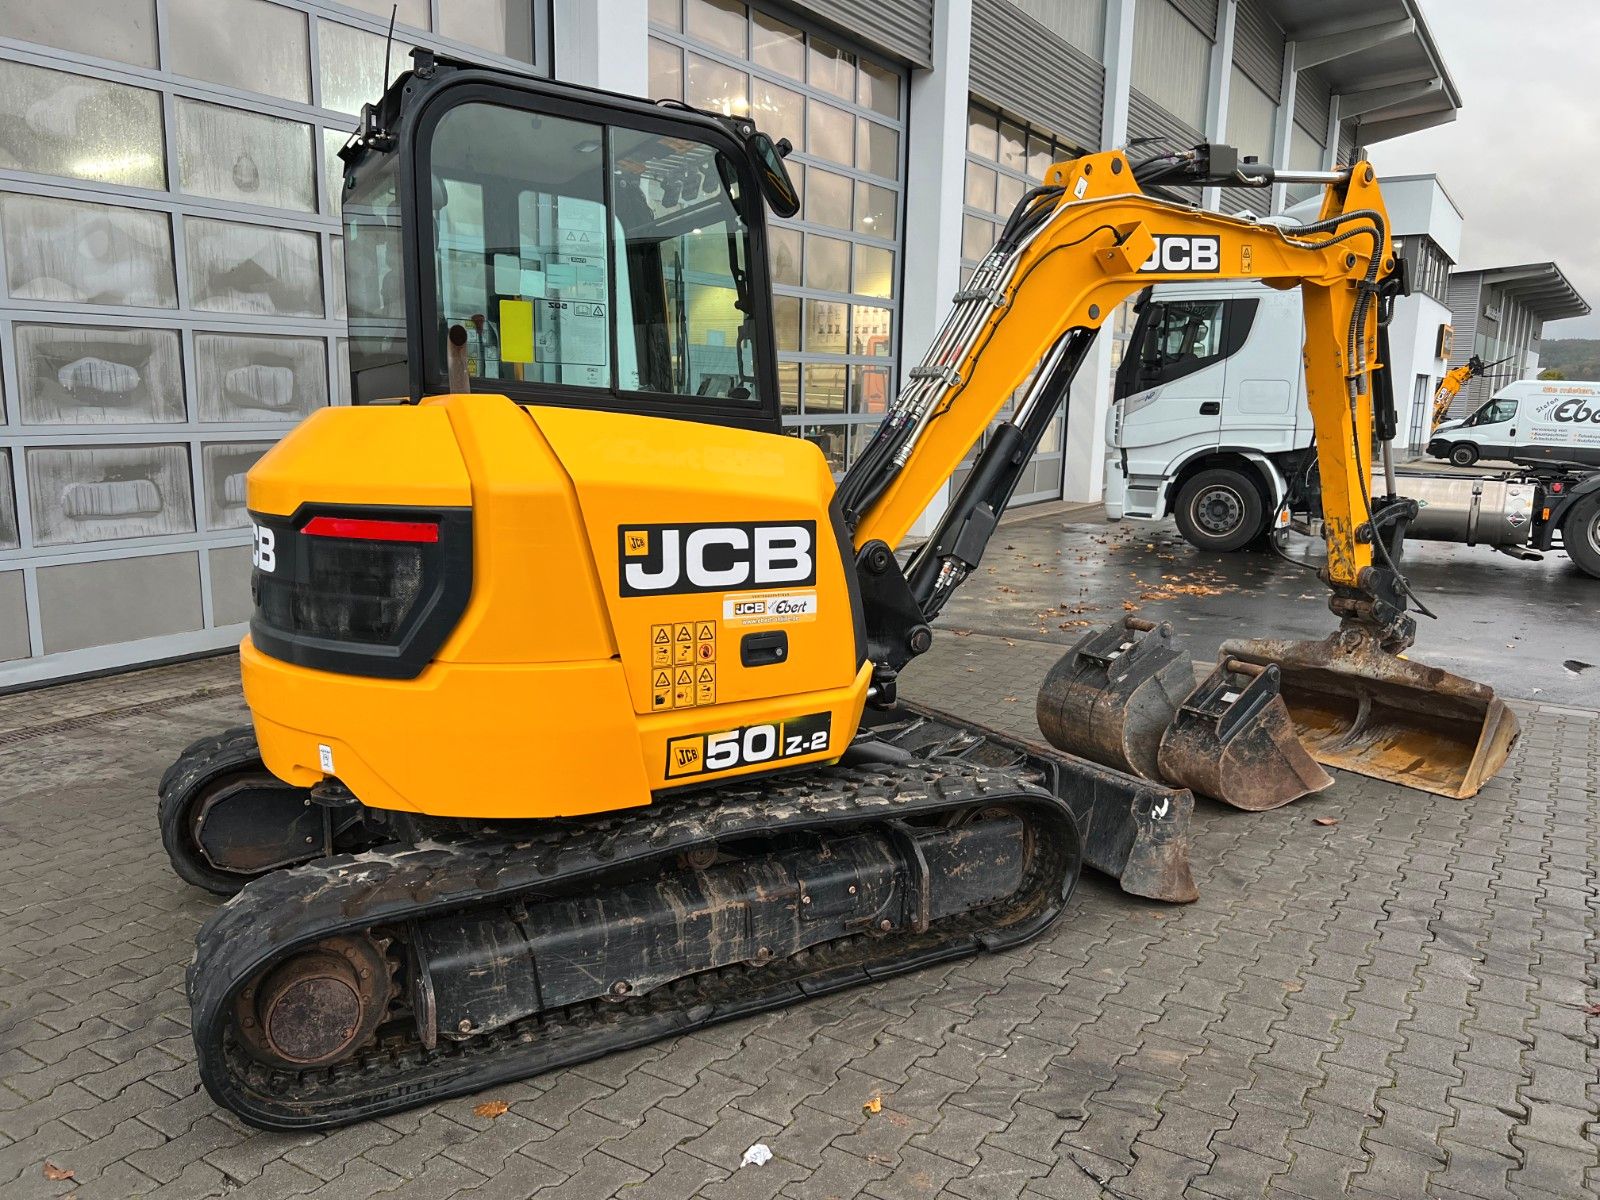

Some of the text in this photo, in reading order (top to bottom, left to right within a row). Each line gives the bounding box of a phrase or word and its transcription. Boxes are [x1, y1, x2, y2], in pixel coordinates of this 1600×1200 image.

[1140, 237, 1218, 271] JCB
[253, 522, 275, 573] CB
[625, 526, 812, 590] JCB
[631, 537, 645, 549] JCB
[735, 603, 765, 615] JCB
[776, 600, 807, 614] Ebert
[678, 724, 828, 770] JCB 50 Z-2
